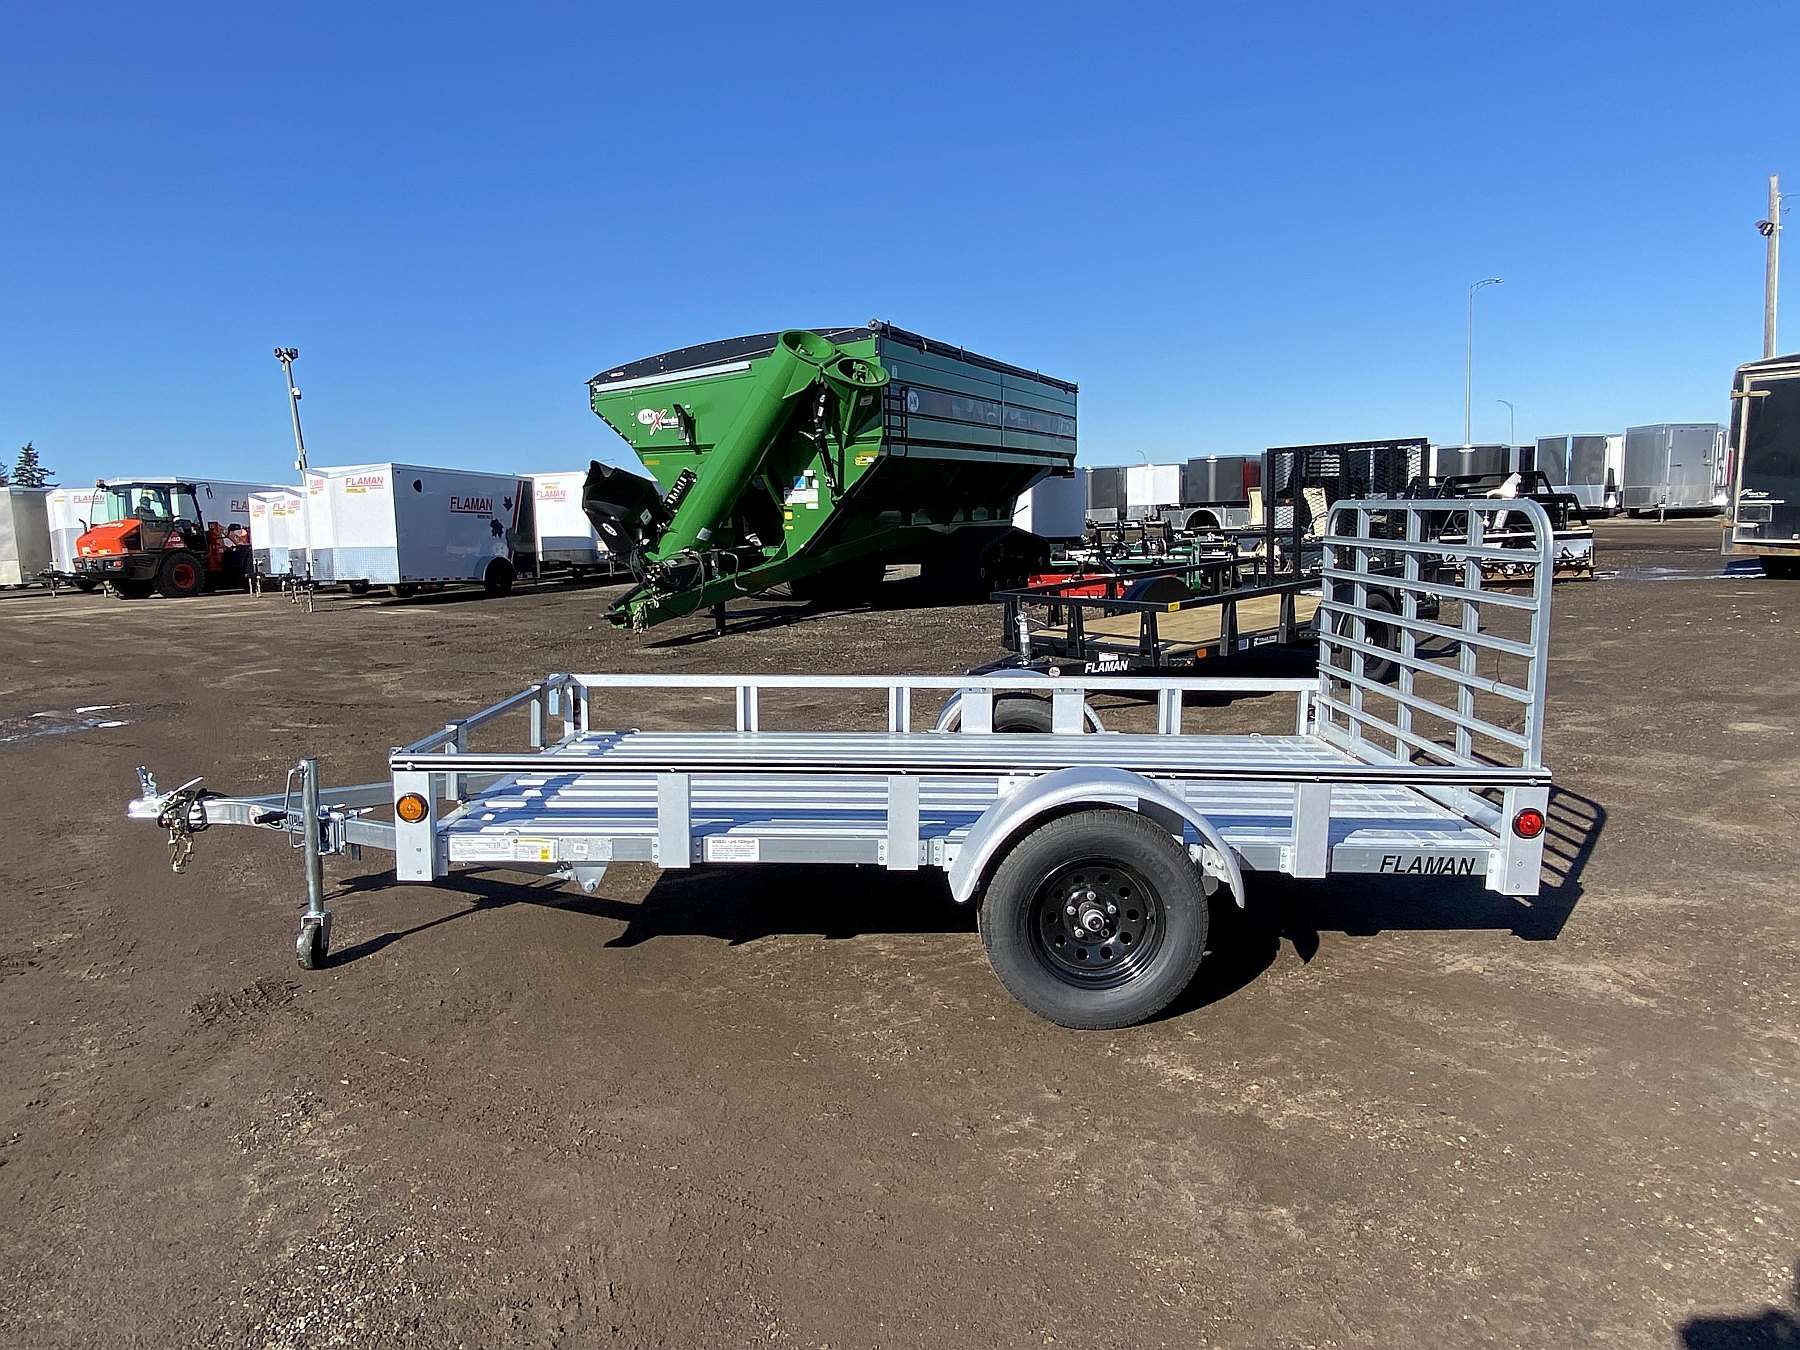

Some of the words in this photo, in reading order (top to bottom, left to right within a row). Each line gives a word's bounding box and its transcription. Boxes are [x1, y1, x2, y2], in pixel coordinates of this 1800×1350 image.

[345, 476, 384, 486] FLAMAN
[536, 489, 567, 498] FLAMAN
[231, 500, 249, 510] FLA
[450, 496, 493, 511] FLAMAN
[1084, 660, 1129, 674] FLAMAN
[1379, 855, 1476, 876] FLAMAN
